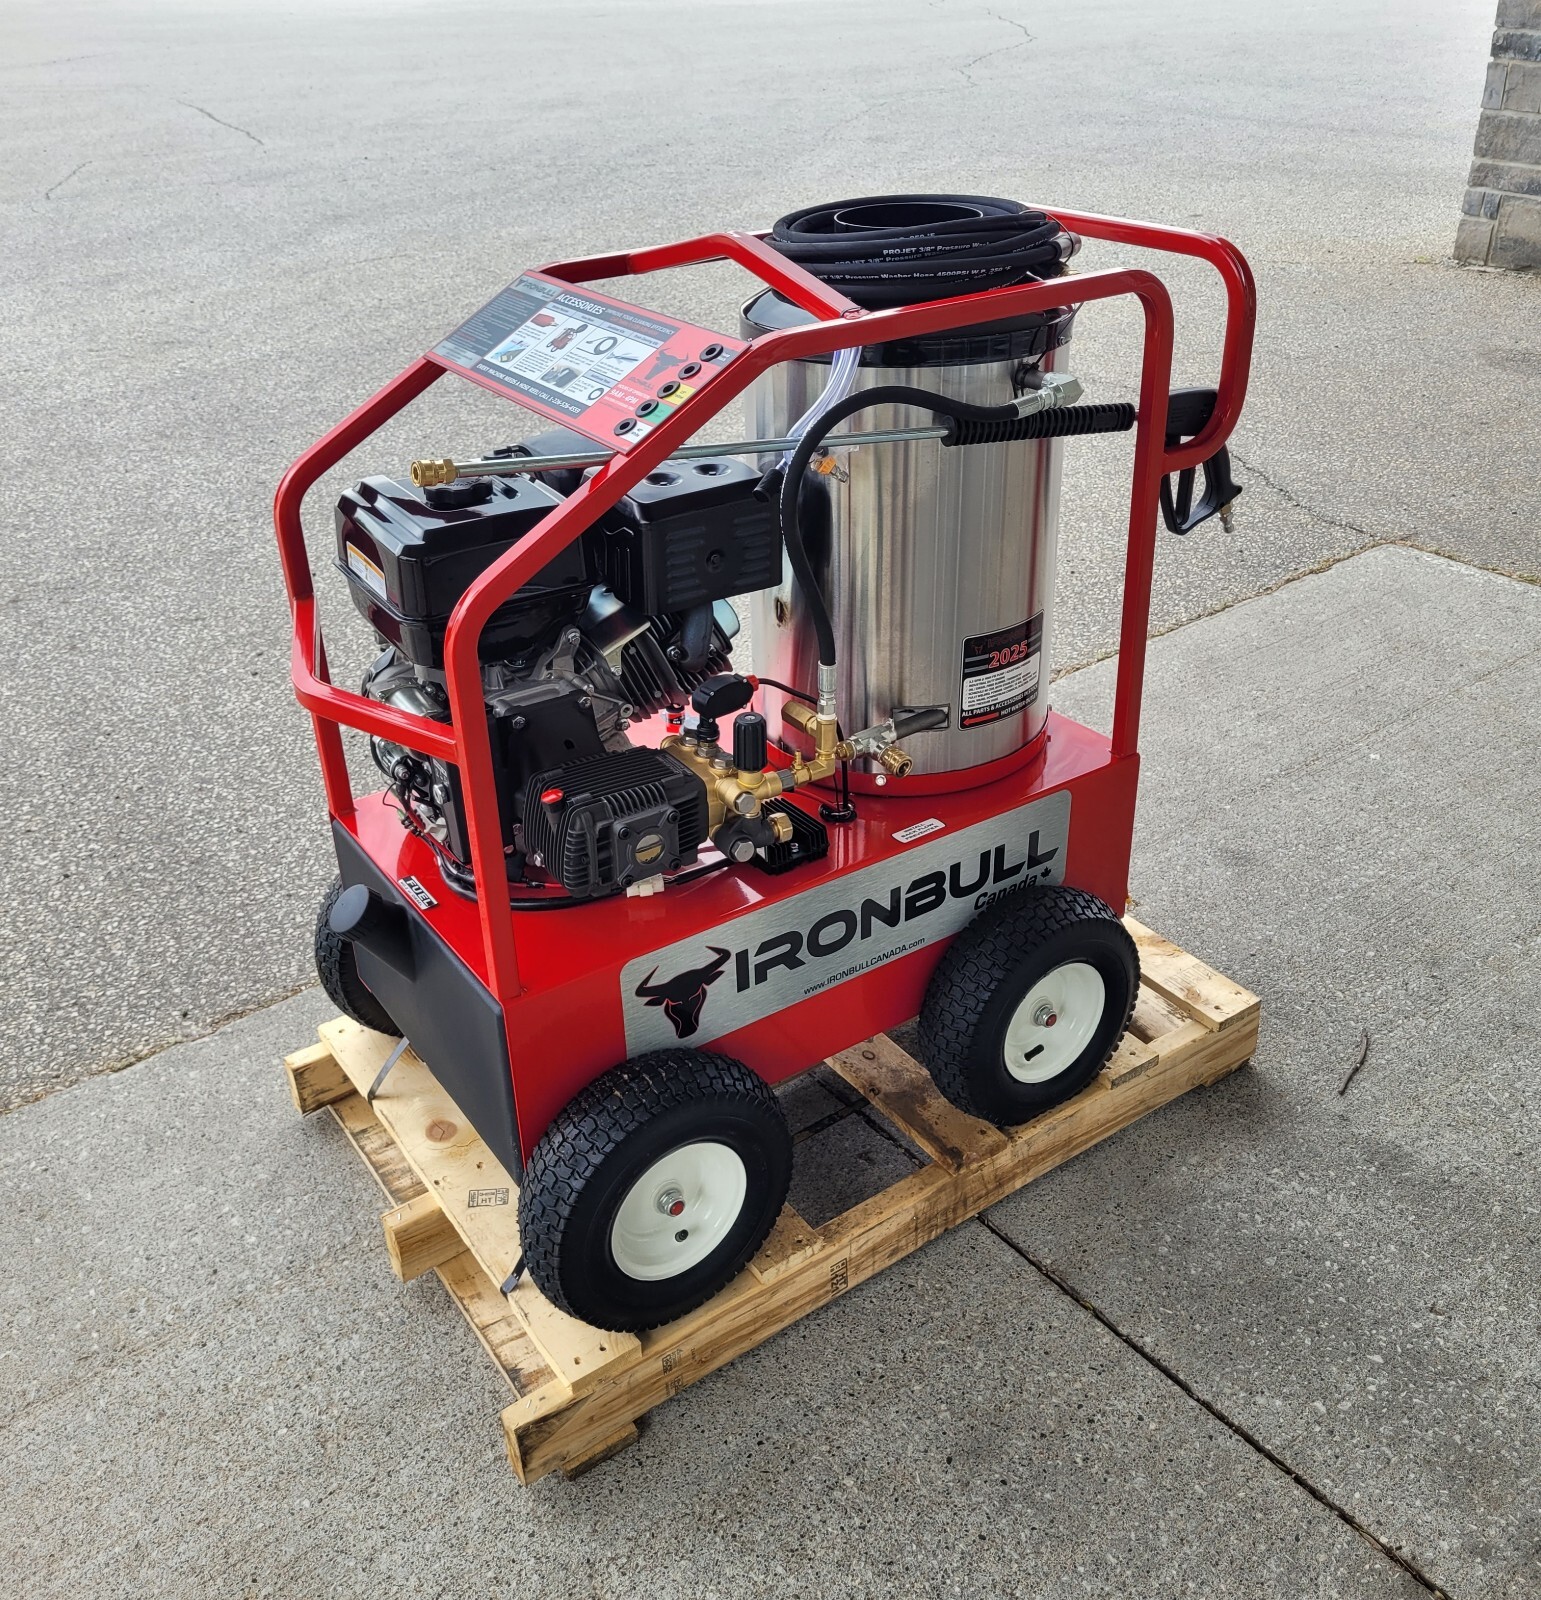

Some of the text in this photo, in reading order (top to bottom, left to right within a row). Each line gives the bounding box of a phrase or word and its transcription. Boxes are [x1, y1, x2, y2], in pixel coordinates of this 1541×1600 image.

[883, 247, 917, 256] PROJET
[937, 243, 970, 251] Pressure
[555, 293, 606, 315] ACCESSORIES
[608, 388, 625, 398] 9AM
[623, 394, 640, 404] 4PM
[989, 640, 1028, 669] 2025
[973, 707, 990, 715] PARTS
[995, 693, 1024, 709] ACCESSORIES
[1000, 708, 1011, 716] HOT
[407, 879, 431, 908] FUEL
[974, 874, 1038, 910] Canada
[735, 830, 1059, 993] IRONBULL
[804, 938, 925, 994] www.IRONBULLCANADA.com
